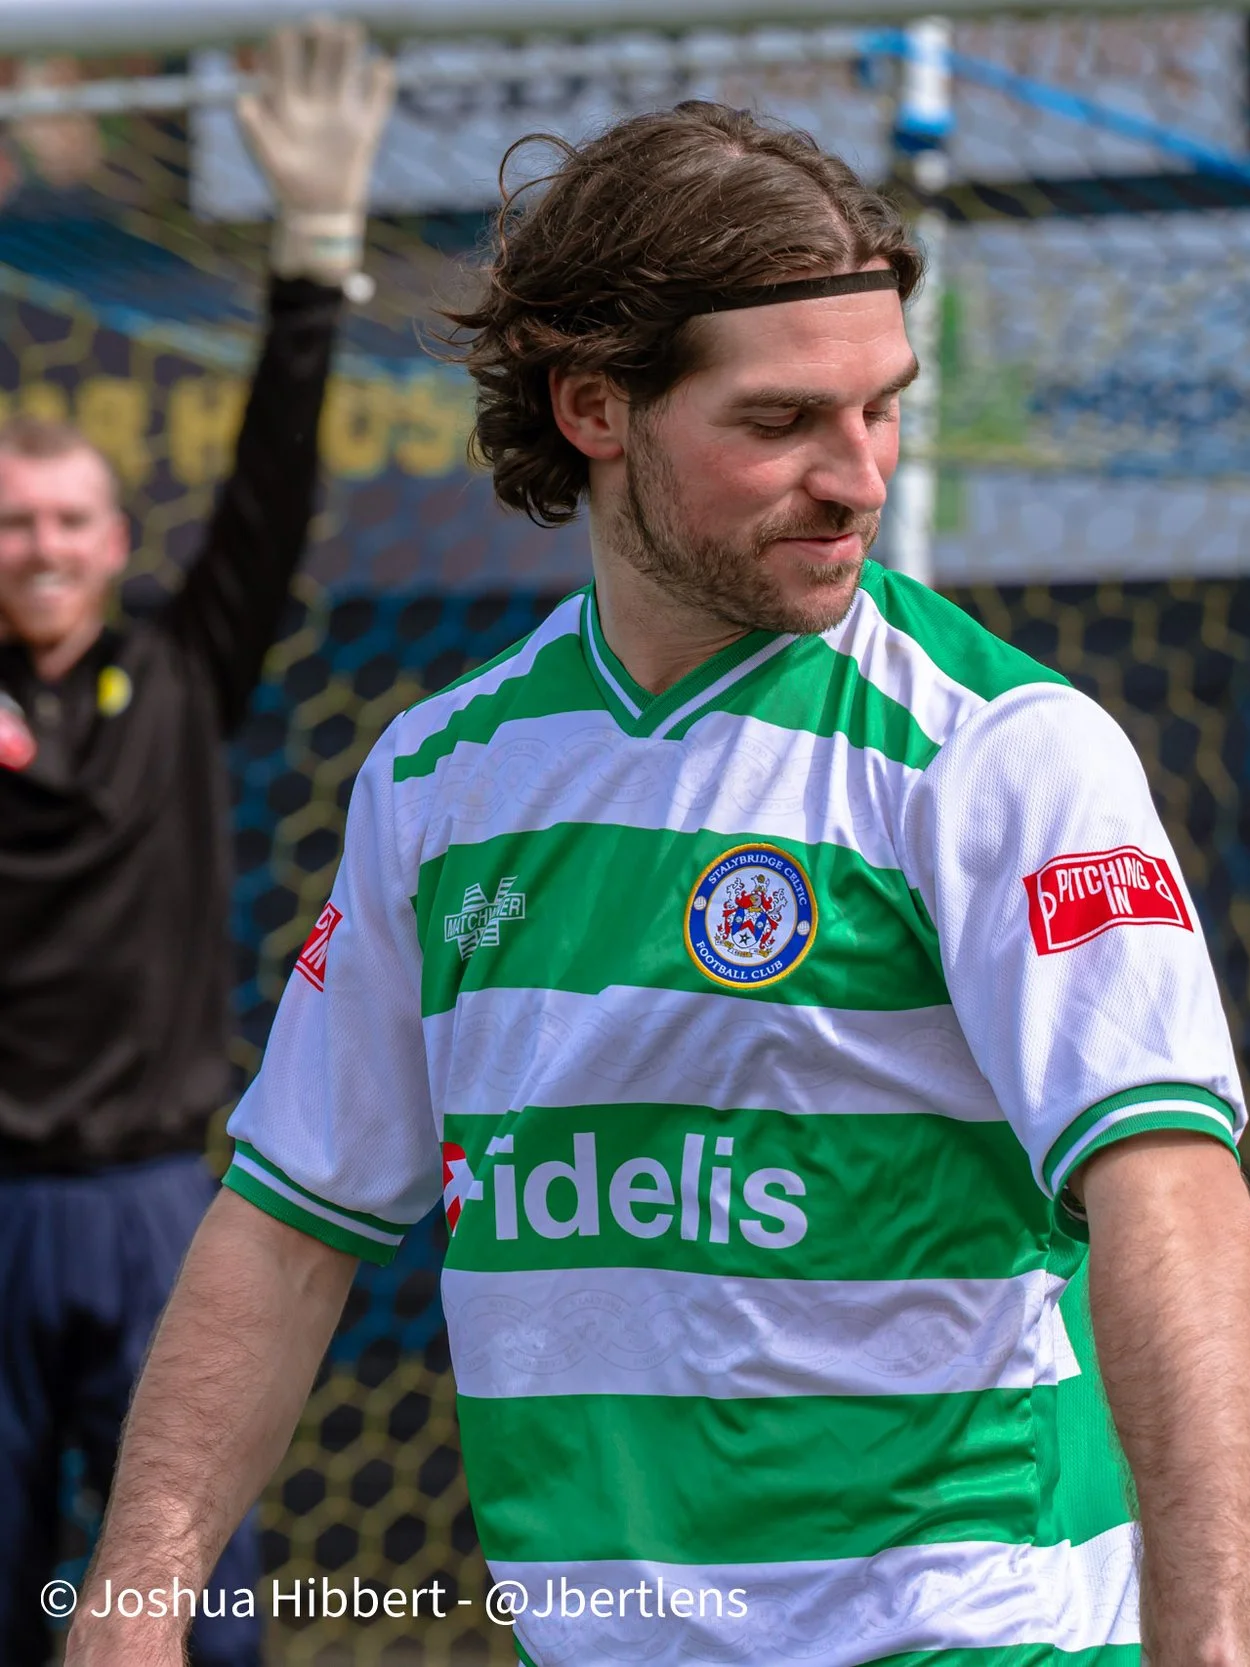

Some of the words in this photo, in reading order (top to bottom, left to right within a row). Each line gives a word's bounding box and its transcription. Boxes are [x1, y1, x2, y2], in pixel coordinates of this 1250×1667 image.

[708, 854, 784, 884] STALYBRIDGE
[784, 867, 807, 906] CELTIC
[1055, 856, 1151, 903] PITCHING
[1108, 883, 1134, 915] IN
[696, 940, 748, 980] FOOTBALL
[751, 960, 783, 979] CLUB
